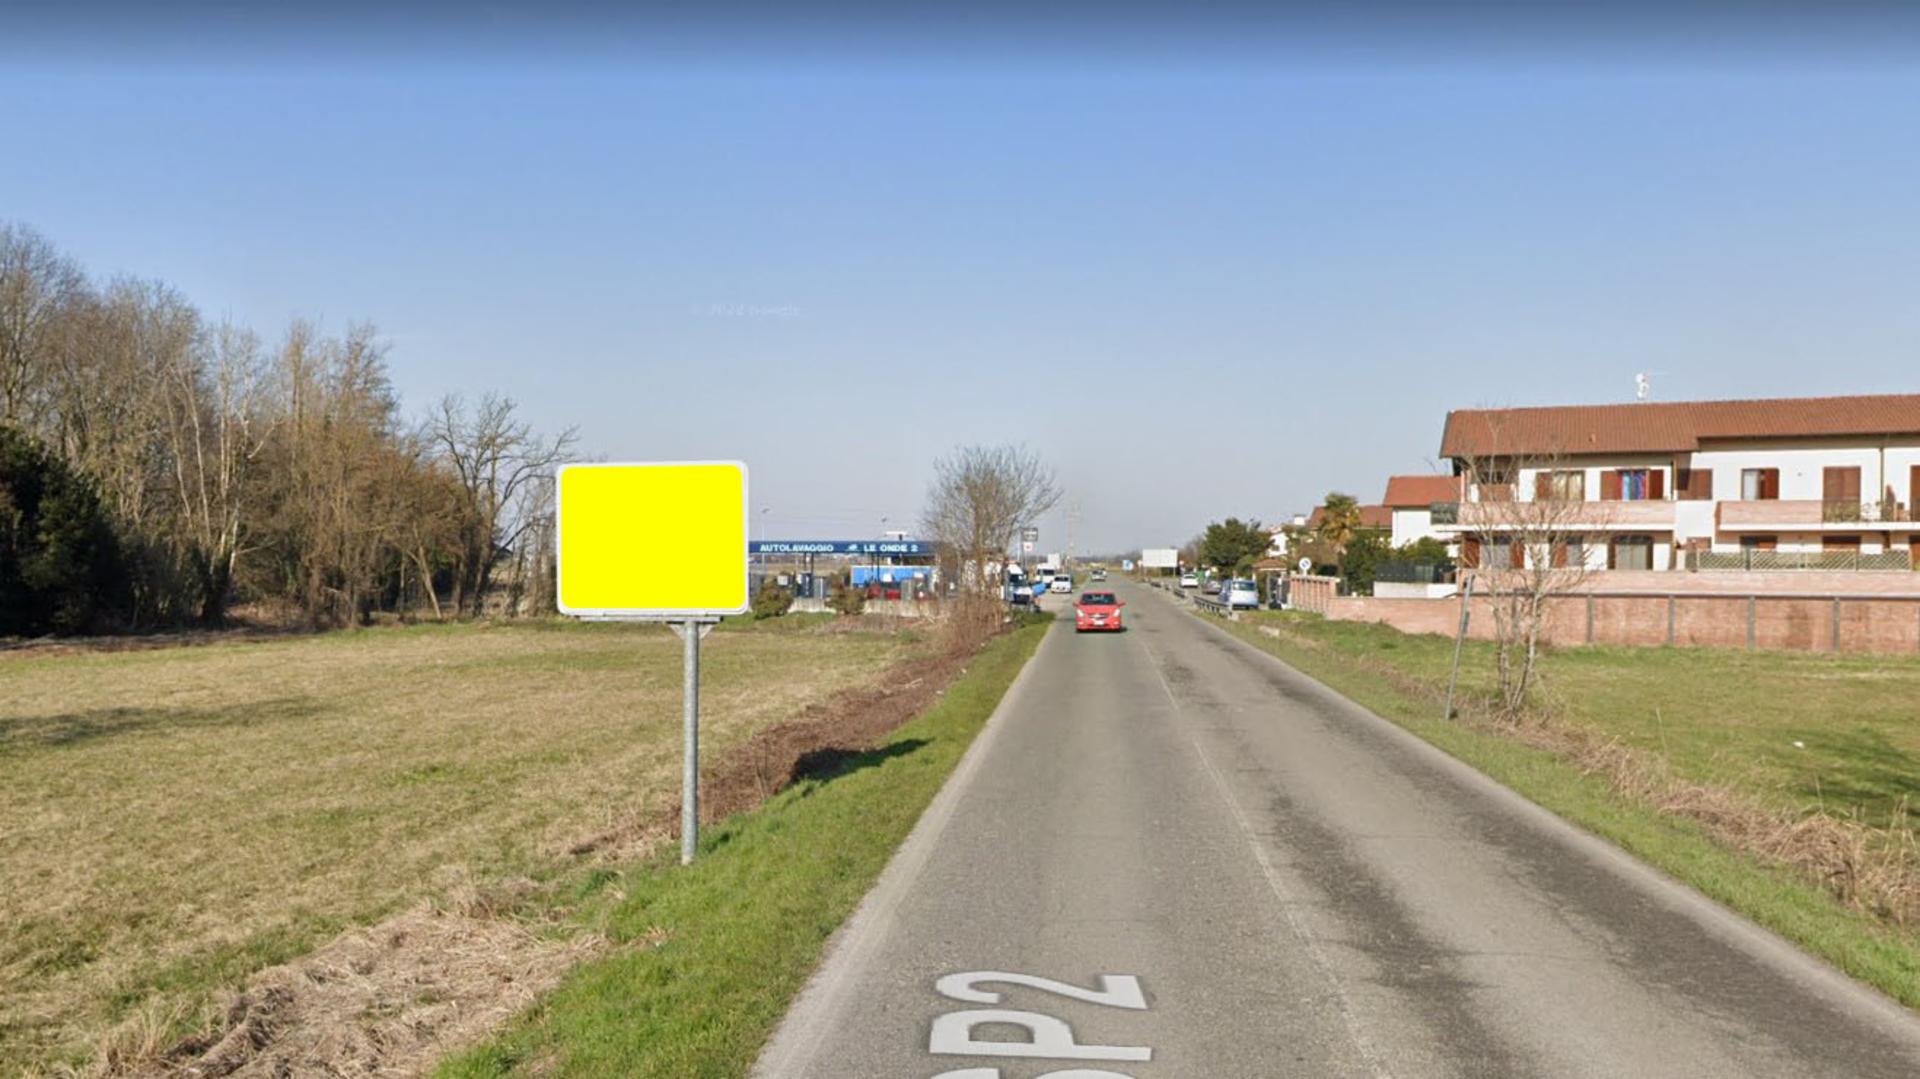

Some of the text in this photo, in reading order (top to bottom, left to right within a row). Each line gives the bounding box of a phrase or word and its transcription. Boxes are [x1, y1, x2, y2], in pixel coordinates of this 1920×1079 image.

[760, 543, 834, 553] AUTOLAVAGGIO
[863, 543, 919, 553] LE ONDE 2
[929, 971, 1152, 1079] P2
